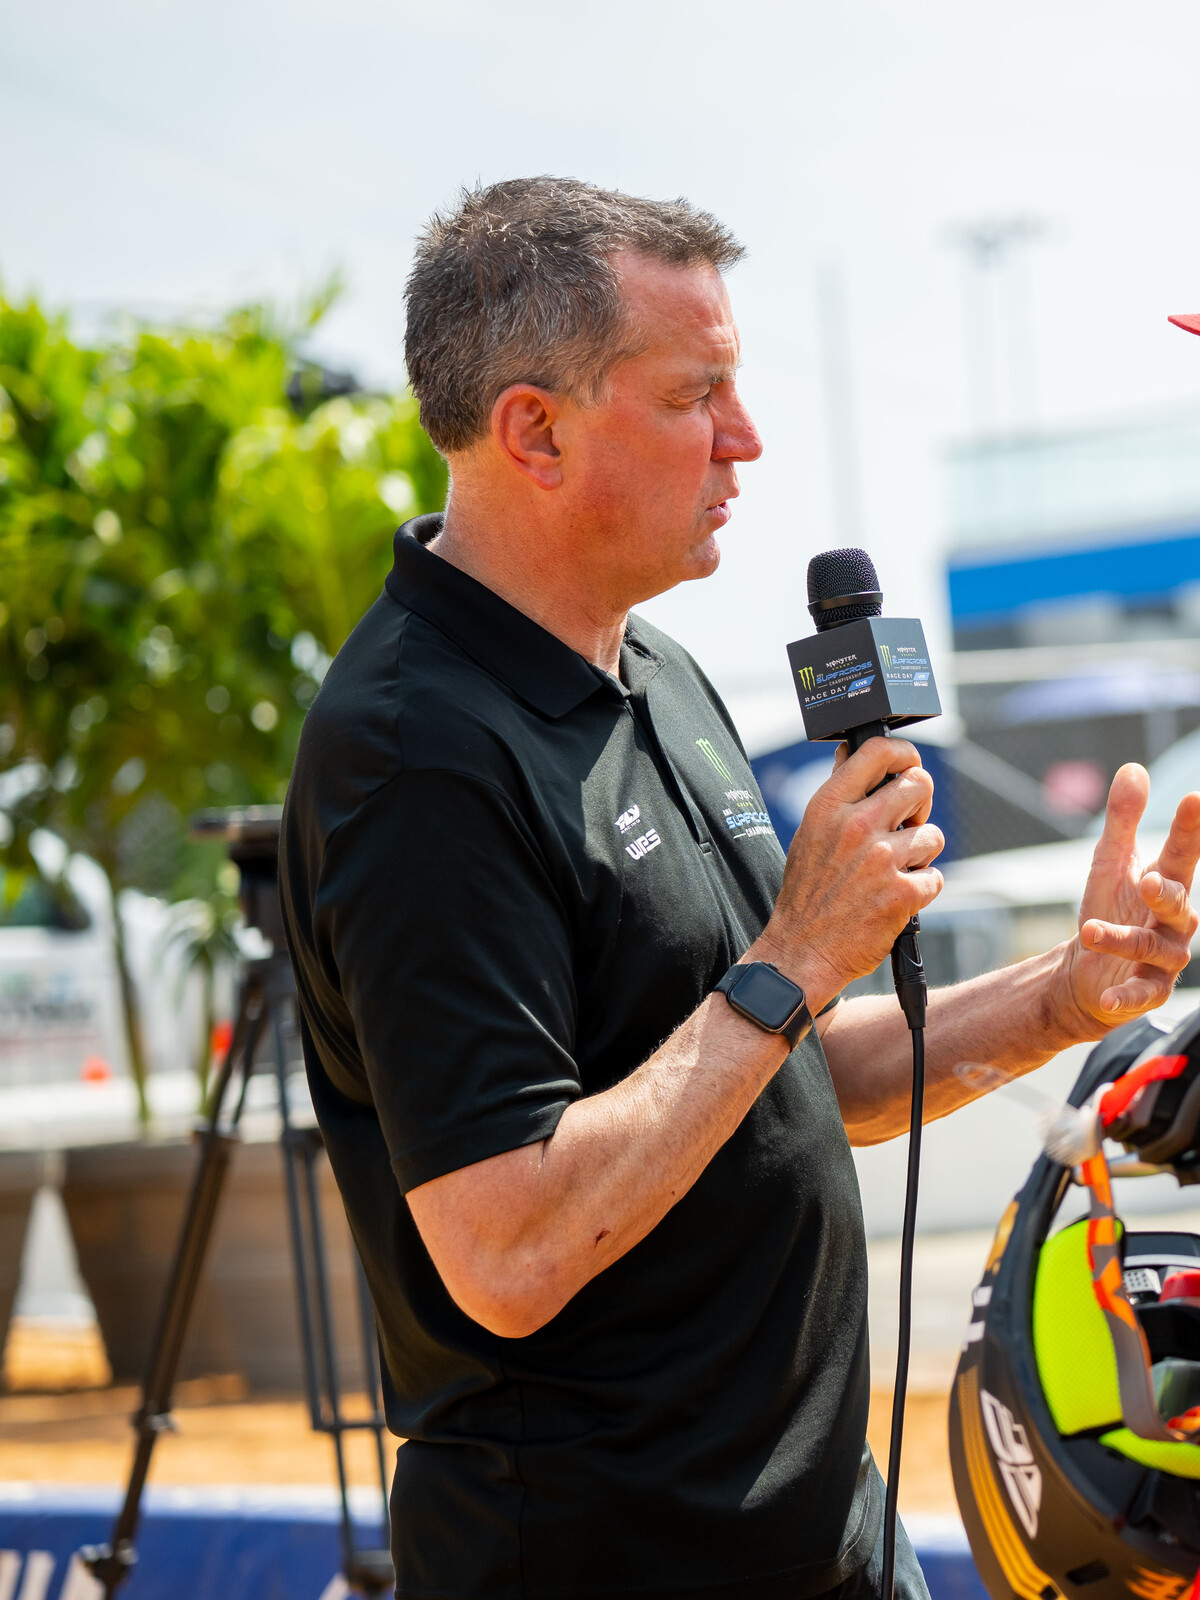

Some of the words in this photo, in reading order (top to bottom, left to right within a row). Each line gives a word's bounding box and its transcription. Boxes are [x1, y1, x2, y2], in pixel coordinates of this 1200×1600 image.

[816, 661, 873, 684] SUPERCROSS
[805, 691, 828, 703] RACE
[830, 685, 847, 695] DAY
[625, 828, 662, 861] WPS
